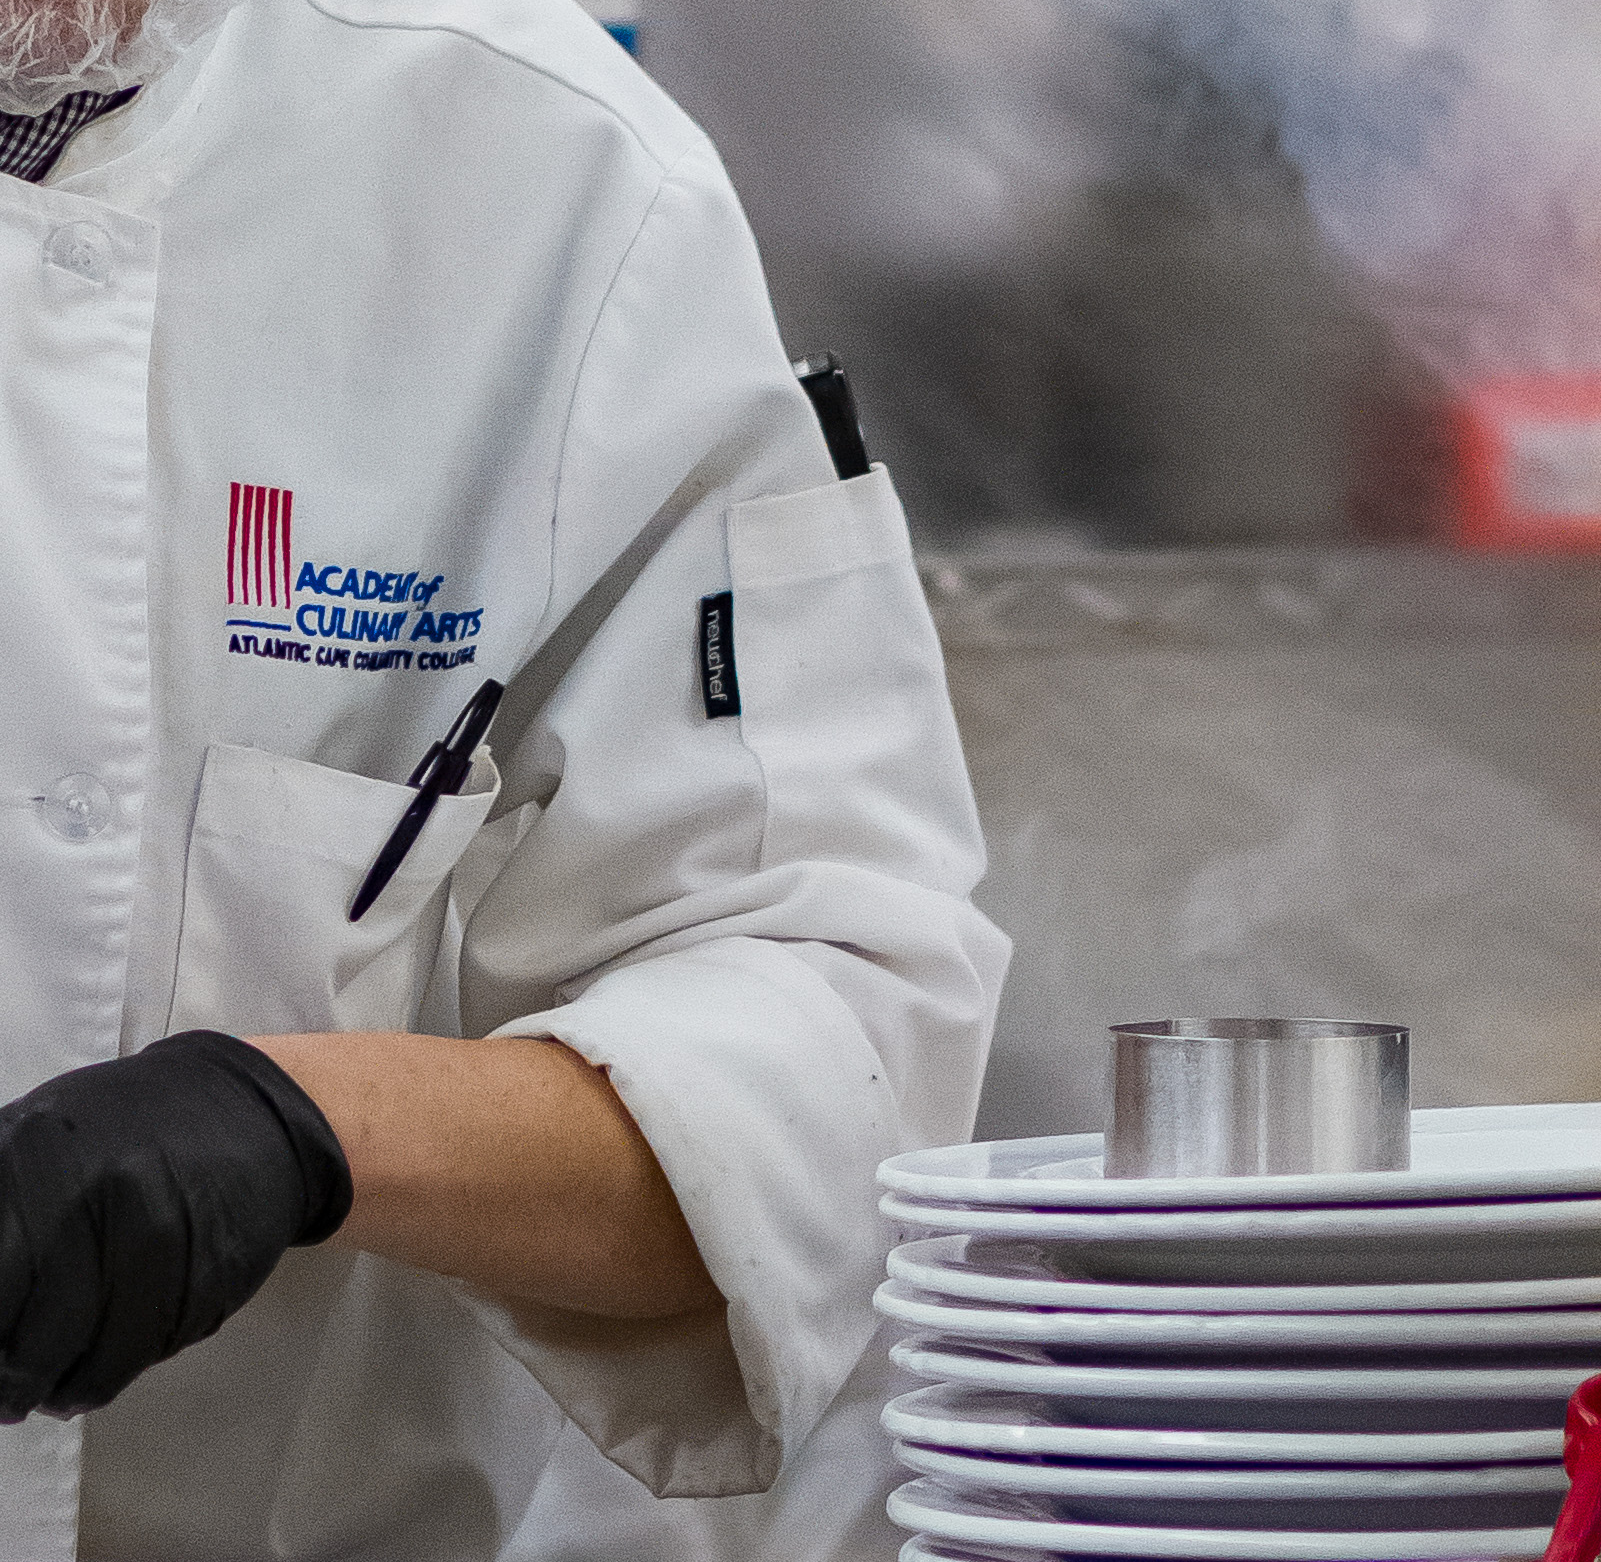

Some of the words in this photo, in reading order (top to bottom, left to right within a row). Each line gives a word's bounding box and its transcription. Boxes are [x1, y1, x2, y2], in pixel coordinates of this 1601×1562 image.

[411, 574, 445, 612] of
[409, 607, 485, 644] ARTS
[228, 633, 312, 663] ATLANTIC
[315, 645, 350, 669] CAPE
